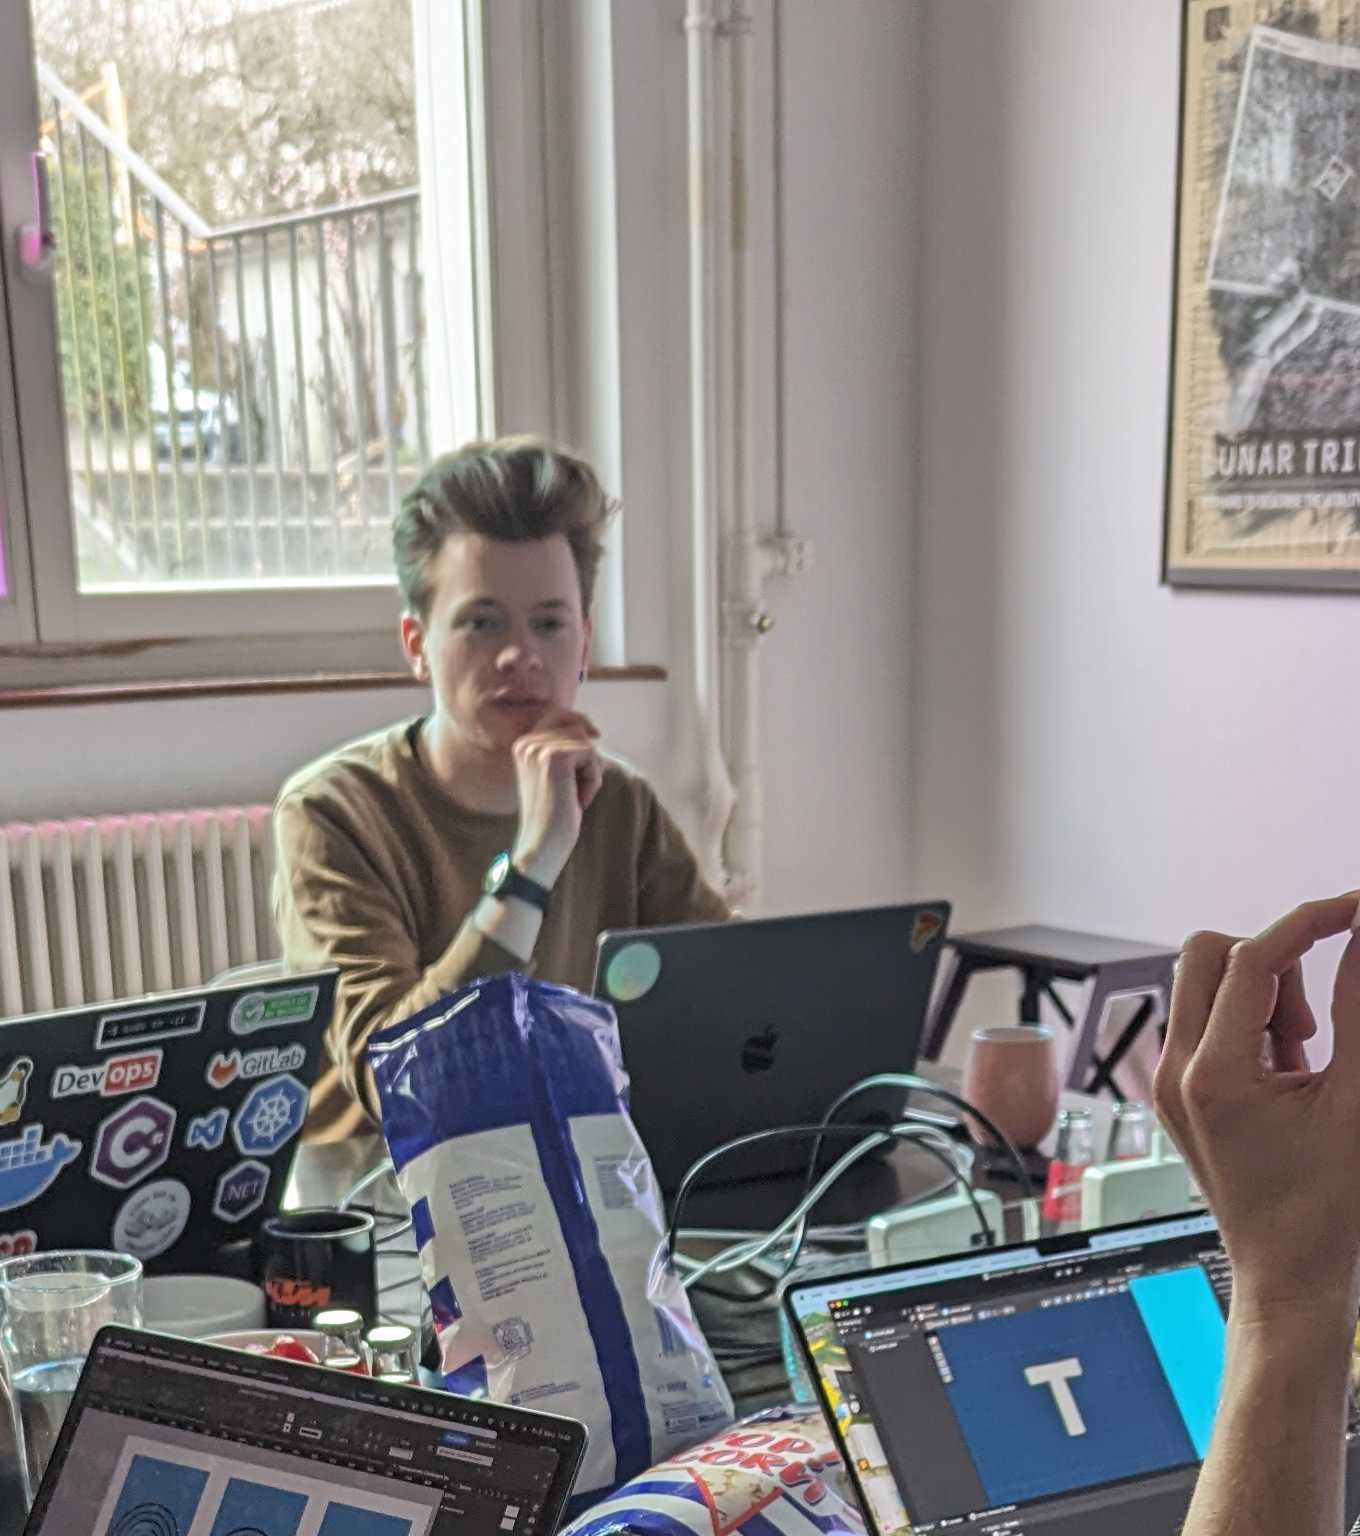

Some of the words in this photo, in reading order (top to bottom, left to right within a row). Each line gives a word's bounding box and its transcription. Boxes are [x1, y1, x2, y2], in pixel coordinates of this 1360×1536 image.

[242, 1047, 302, 1075] GitLab
[223, 1184, 258, 1202] .NET
[1024, 1357, 1087, 1438] T
